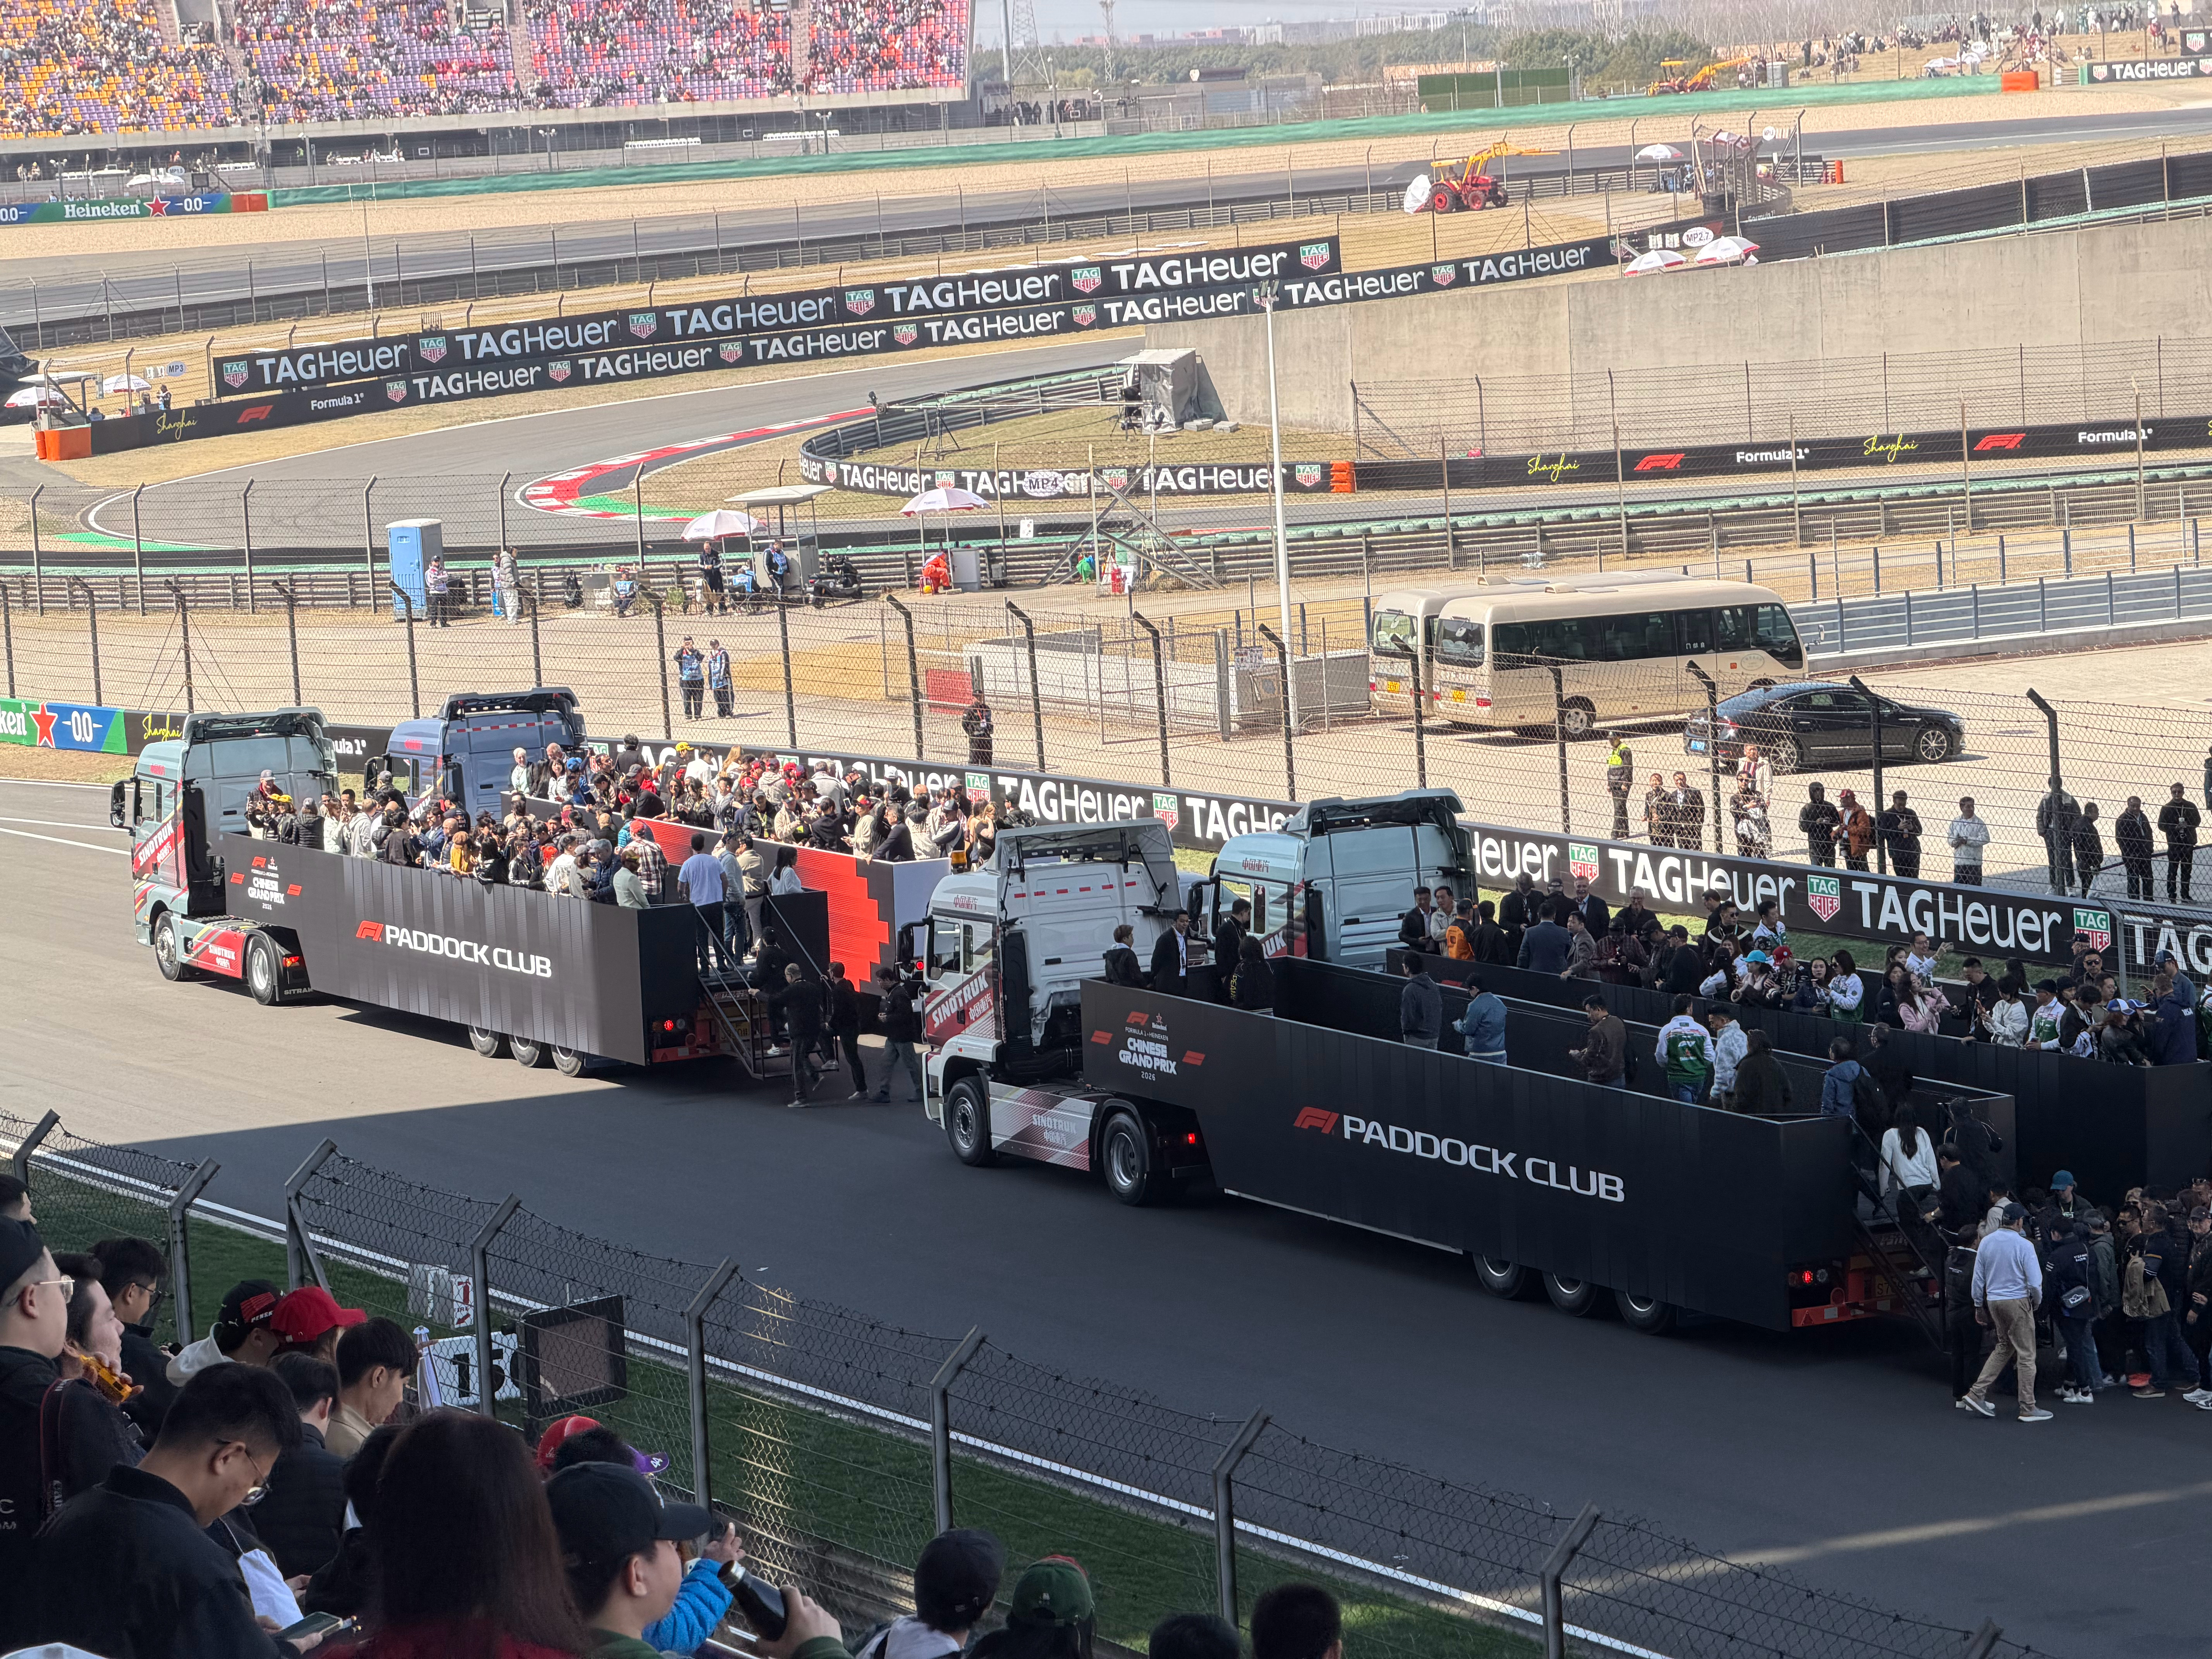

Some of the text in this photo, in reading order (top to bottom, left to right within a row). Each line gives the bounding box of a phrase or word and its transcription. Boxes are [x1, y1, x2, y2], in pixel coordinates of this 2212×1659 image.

[64, 202, 140, 218] Heineken
[1686, 232, 1709, 242] MP2.7
[1302, 244, 1328, 255] TAG
[1302, 253, 1329, 267] HEUER
[1074, 268, 1099, 279] TAG
[1434, 265, 1454, 273] TAG
[1074, 277, 1101, 291] HEUER
[847, 290, 873, 301] TAG
[847, 300, 874, 313] HEUER
[1075, 306, 1094, 314] TAG
[631, 314, 654, 325] TAG
[631, 323, 655, 336] HEUER
[895, 325, 915, 333] TAG
[422, 338, 444, 348] TAG
[721, 342, 740, 351] TAG
[422, 347, 446, 361] HEUER
[169, 364, 184, 373] MP3
[226, 362, 247, 373] TAG
[550, 361, 569, 370] TAG
[225, 371, 247, 384] HEUER
[388, 382, 405, 390] TAG
[311, 396, 353, 410] Formula
[156, 409, 198, 440] Shanghai
[2078, 430, 2137, 443] Formula
[1864, 433, 1918, 462] Shanghai
[1736, 449, 1792, 462] Formula
[1527, 453, 1580, 481] Shanghai
[1028, 478, 1059, 489] MP4
[968, 775, 988, 788] TAG
[1155, 796, 1176, 810] TAG
[1571, 845, 1596, 862] TAG
[1242, 857, 1270, 873] 中国重汽
[1809, 878, 1837, 896] TAG
[1809, 893, 1840, 920] HEUER
[2076, 911, 2108, 929] TAG
[385, 924, 552, 978] PADDOCK CLUB
[932, 971, 989, 1029] SINOTRUK
[1125, 1026, 1143, 1036] FORMULA
[1127, 1037, 1168, 1058] CHINESE
[1119, 1049, 1177, 1075] GRAND PRIX
[1141, 1071, 1156, 1081] 2026
[1032, 1114, 1077, 1133] SINOTRUK
[1343, 1114, 1625, 1202] PADDOCK CLUB
[650, 1457, 663, 1468] 44
